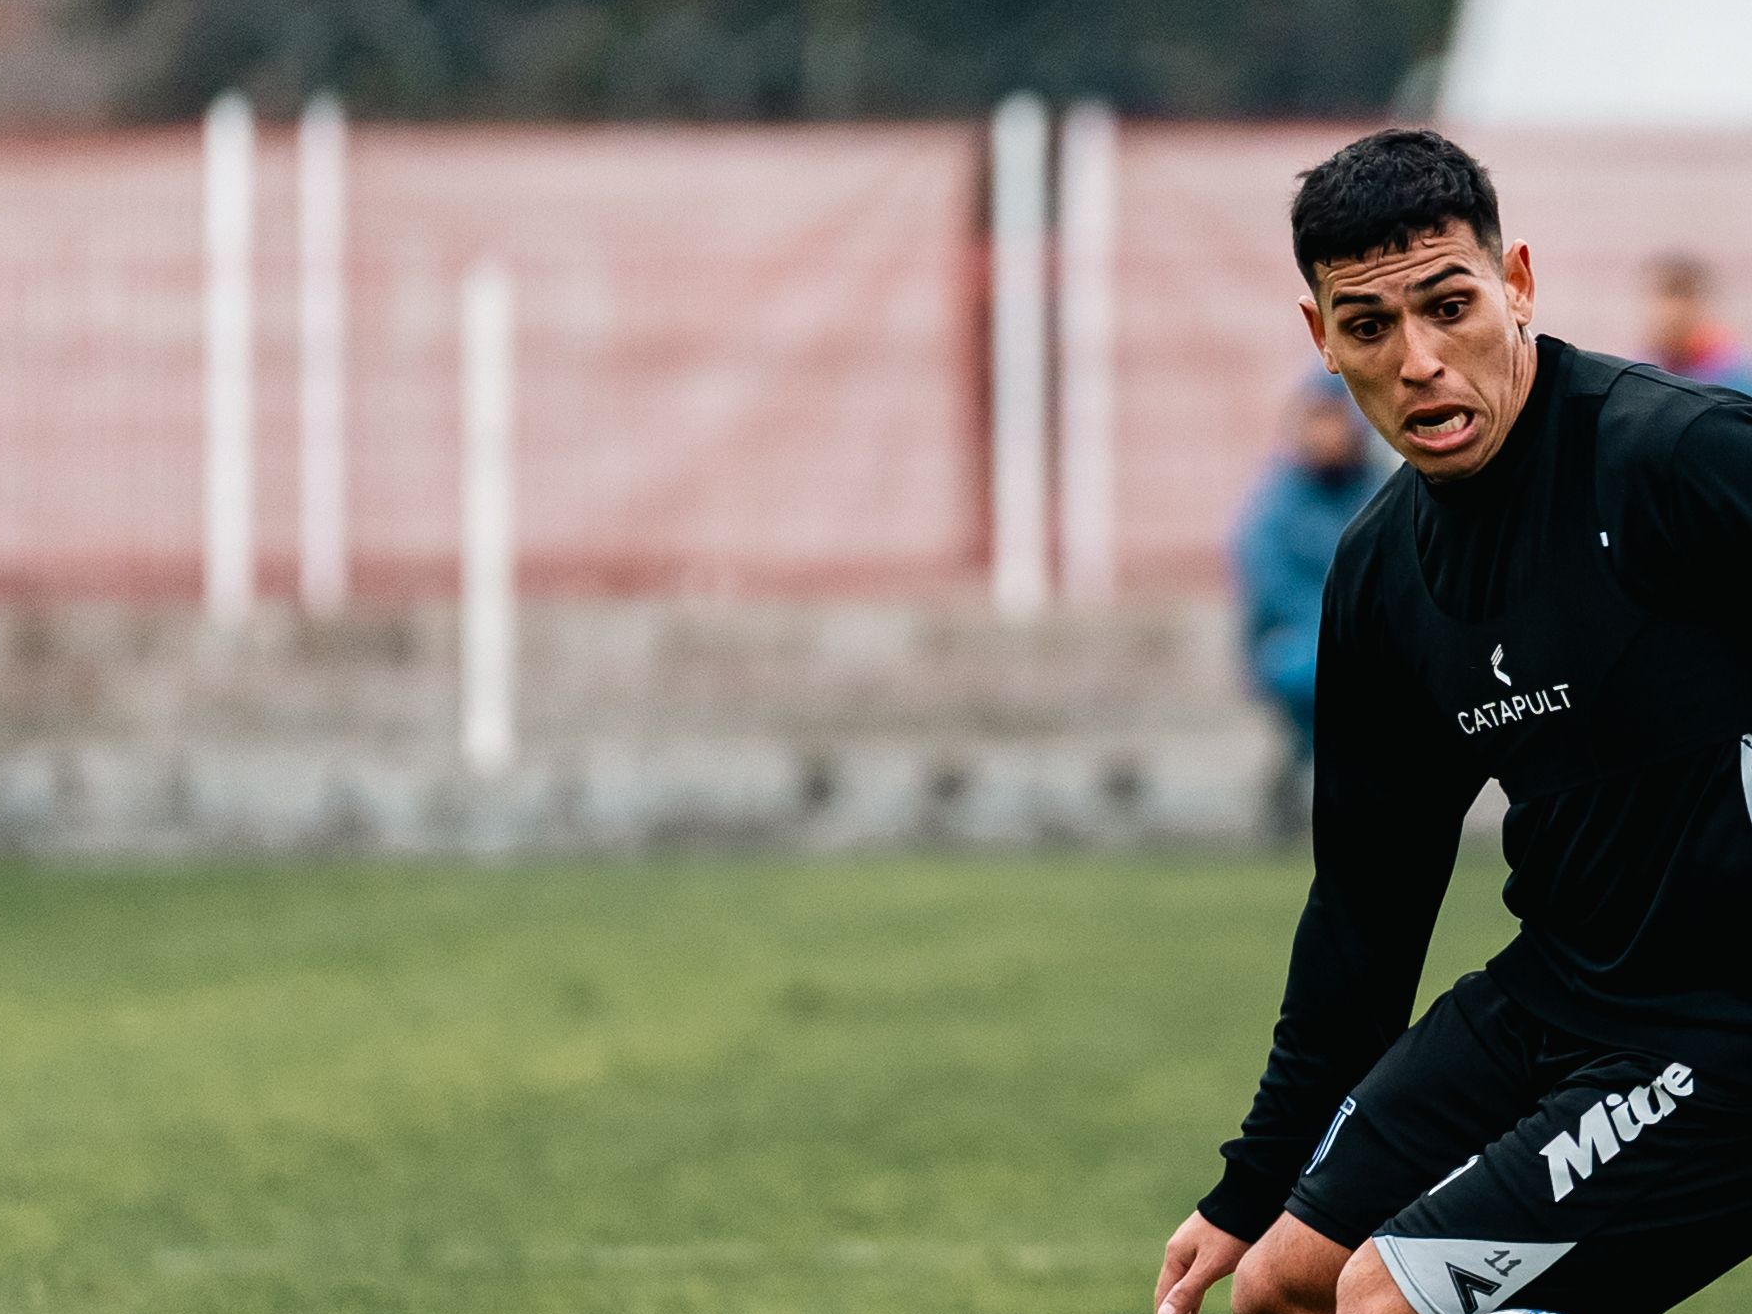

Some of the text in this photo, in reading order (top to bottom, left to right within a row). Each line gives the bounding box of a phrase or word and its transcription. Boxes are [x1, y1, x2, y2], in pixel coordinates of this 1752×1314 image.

[1457, 684, 1571, 735] CATAPULT
[1539, 1062, 1694, 1203] Mitre
[1484, 1250, 1522, 1277] 11
